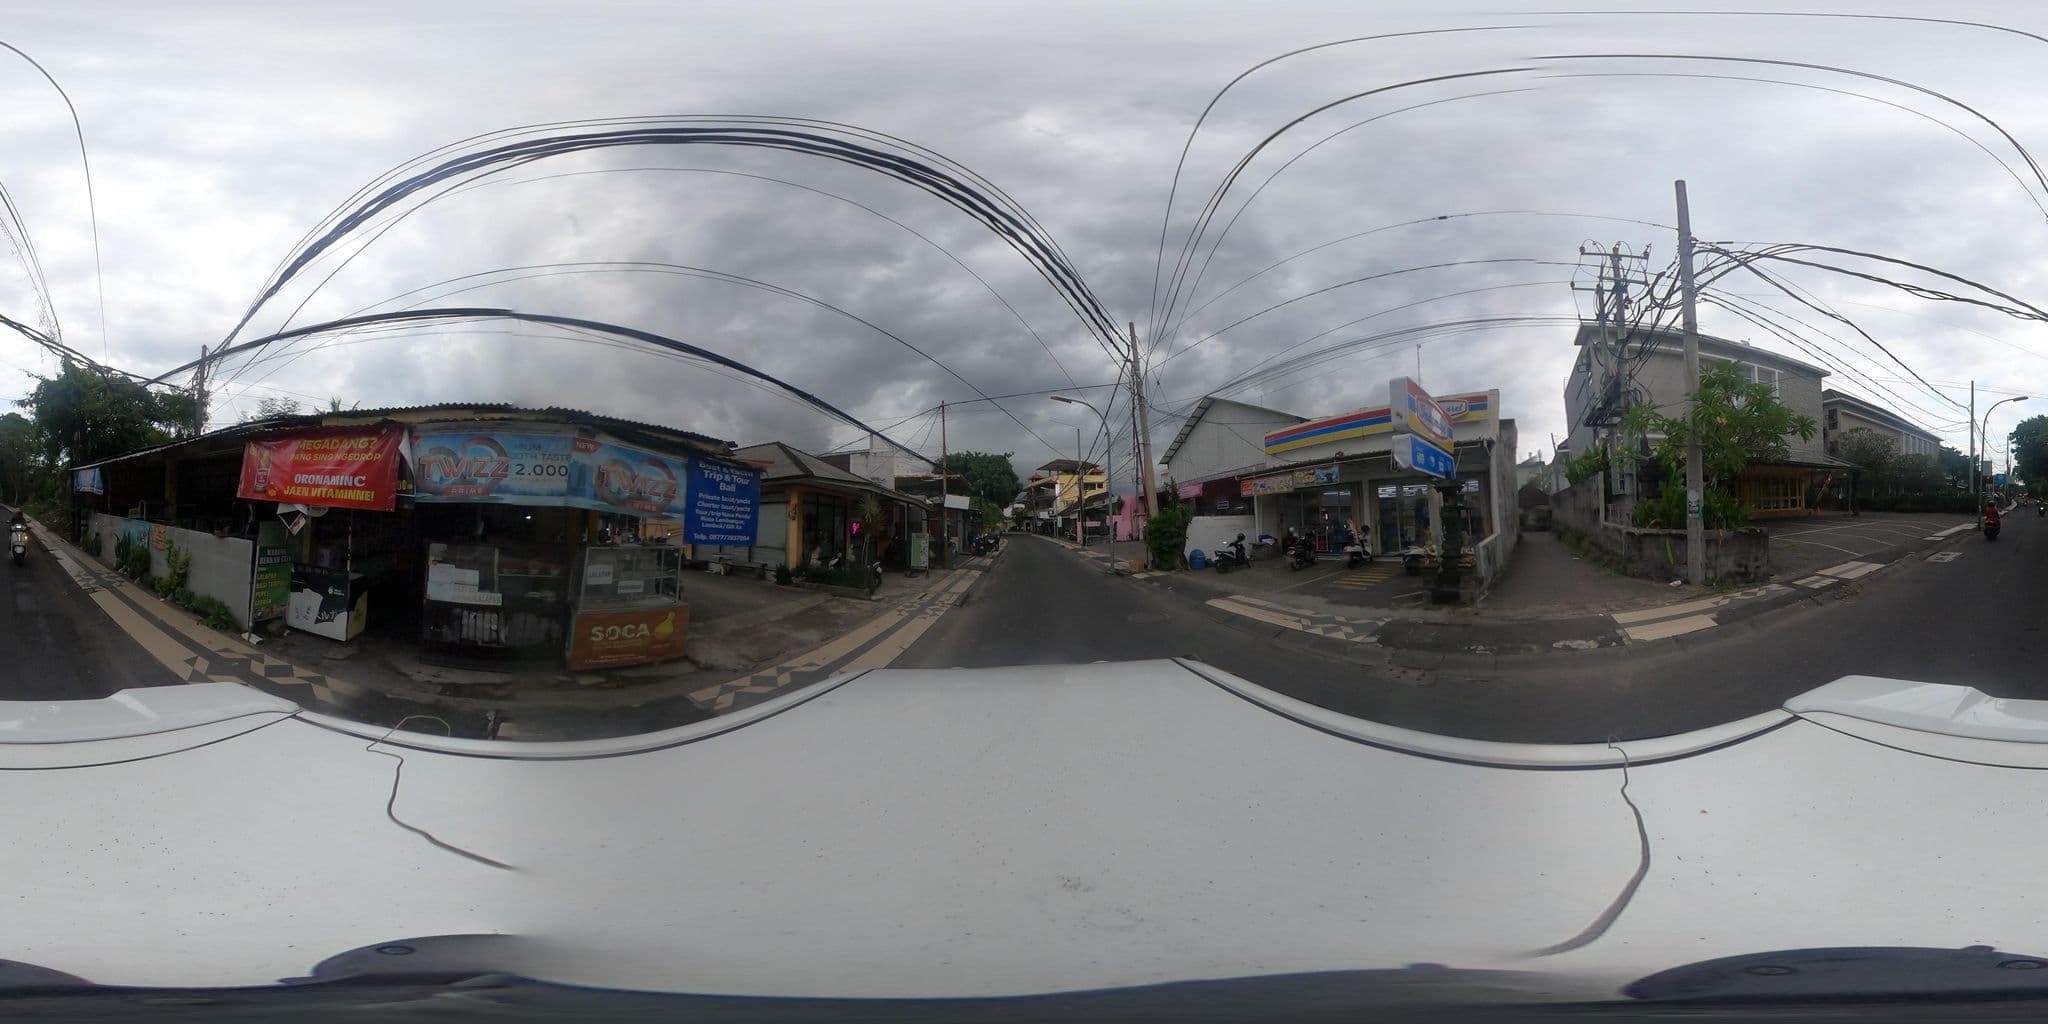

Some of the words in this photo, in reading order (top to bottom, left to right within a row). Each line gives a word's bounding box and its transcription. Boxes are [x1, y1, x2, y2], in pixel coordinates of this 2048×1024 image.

[298, 437, 379, 450] MEGADANG?
[576, 441, 594, 450] NEW
[418, 455, 509, 480] TWIZZ
[514, 462, 569, 477] 2.000
[599, 463, 678, 500] TWIZZ
[703, 470, 723, 482] Trip
[724, 474, 731, 482] &
[731, 475, 750, 485] Tour
[284, 485, 310, 496] JAEN
[719, 482, 736, 492] Bali
[591, 623, 650, 641] SOCA
